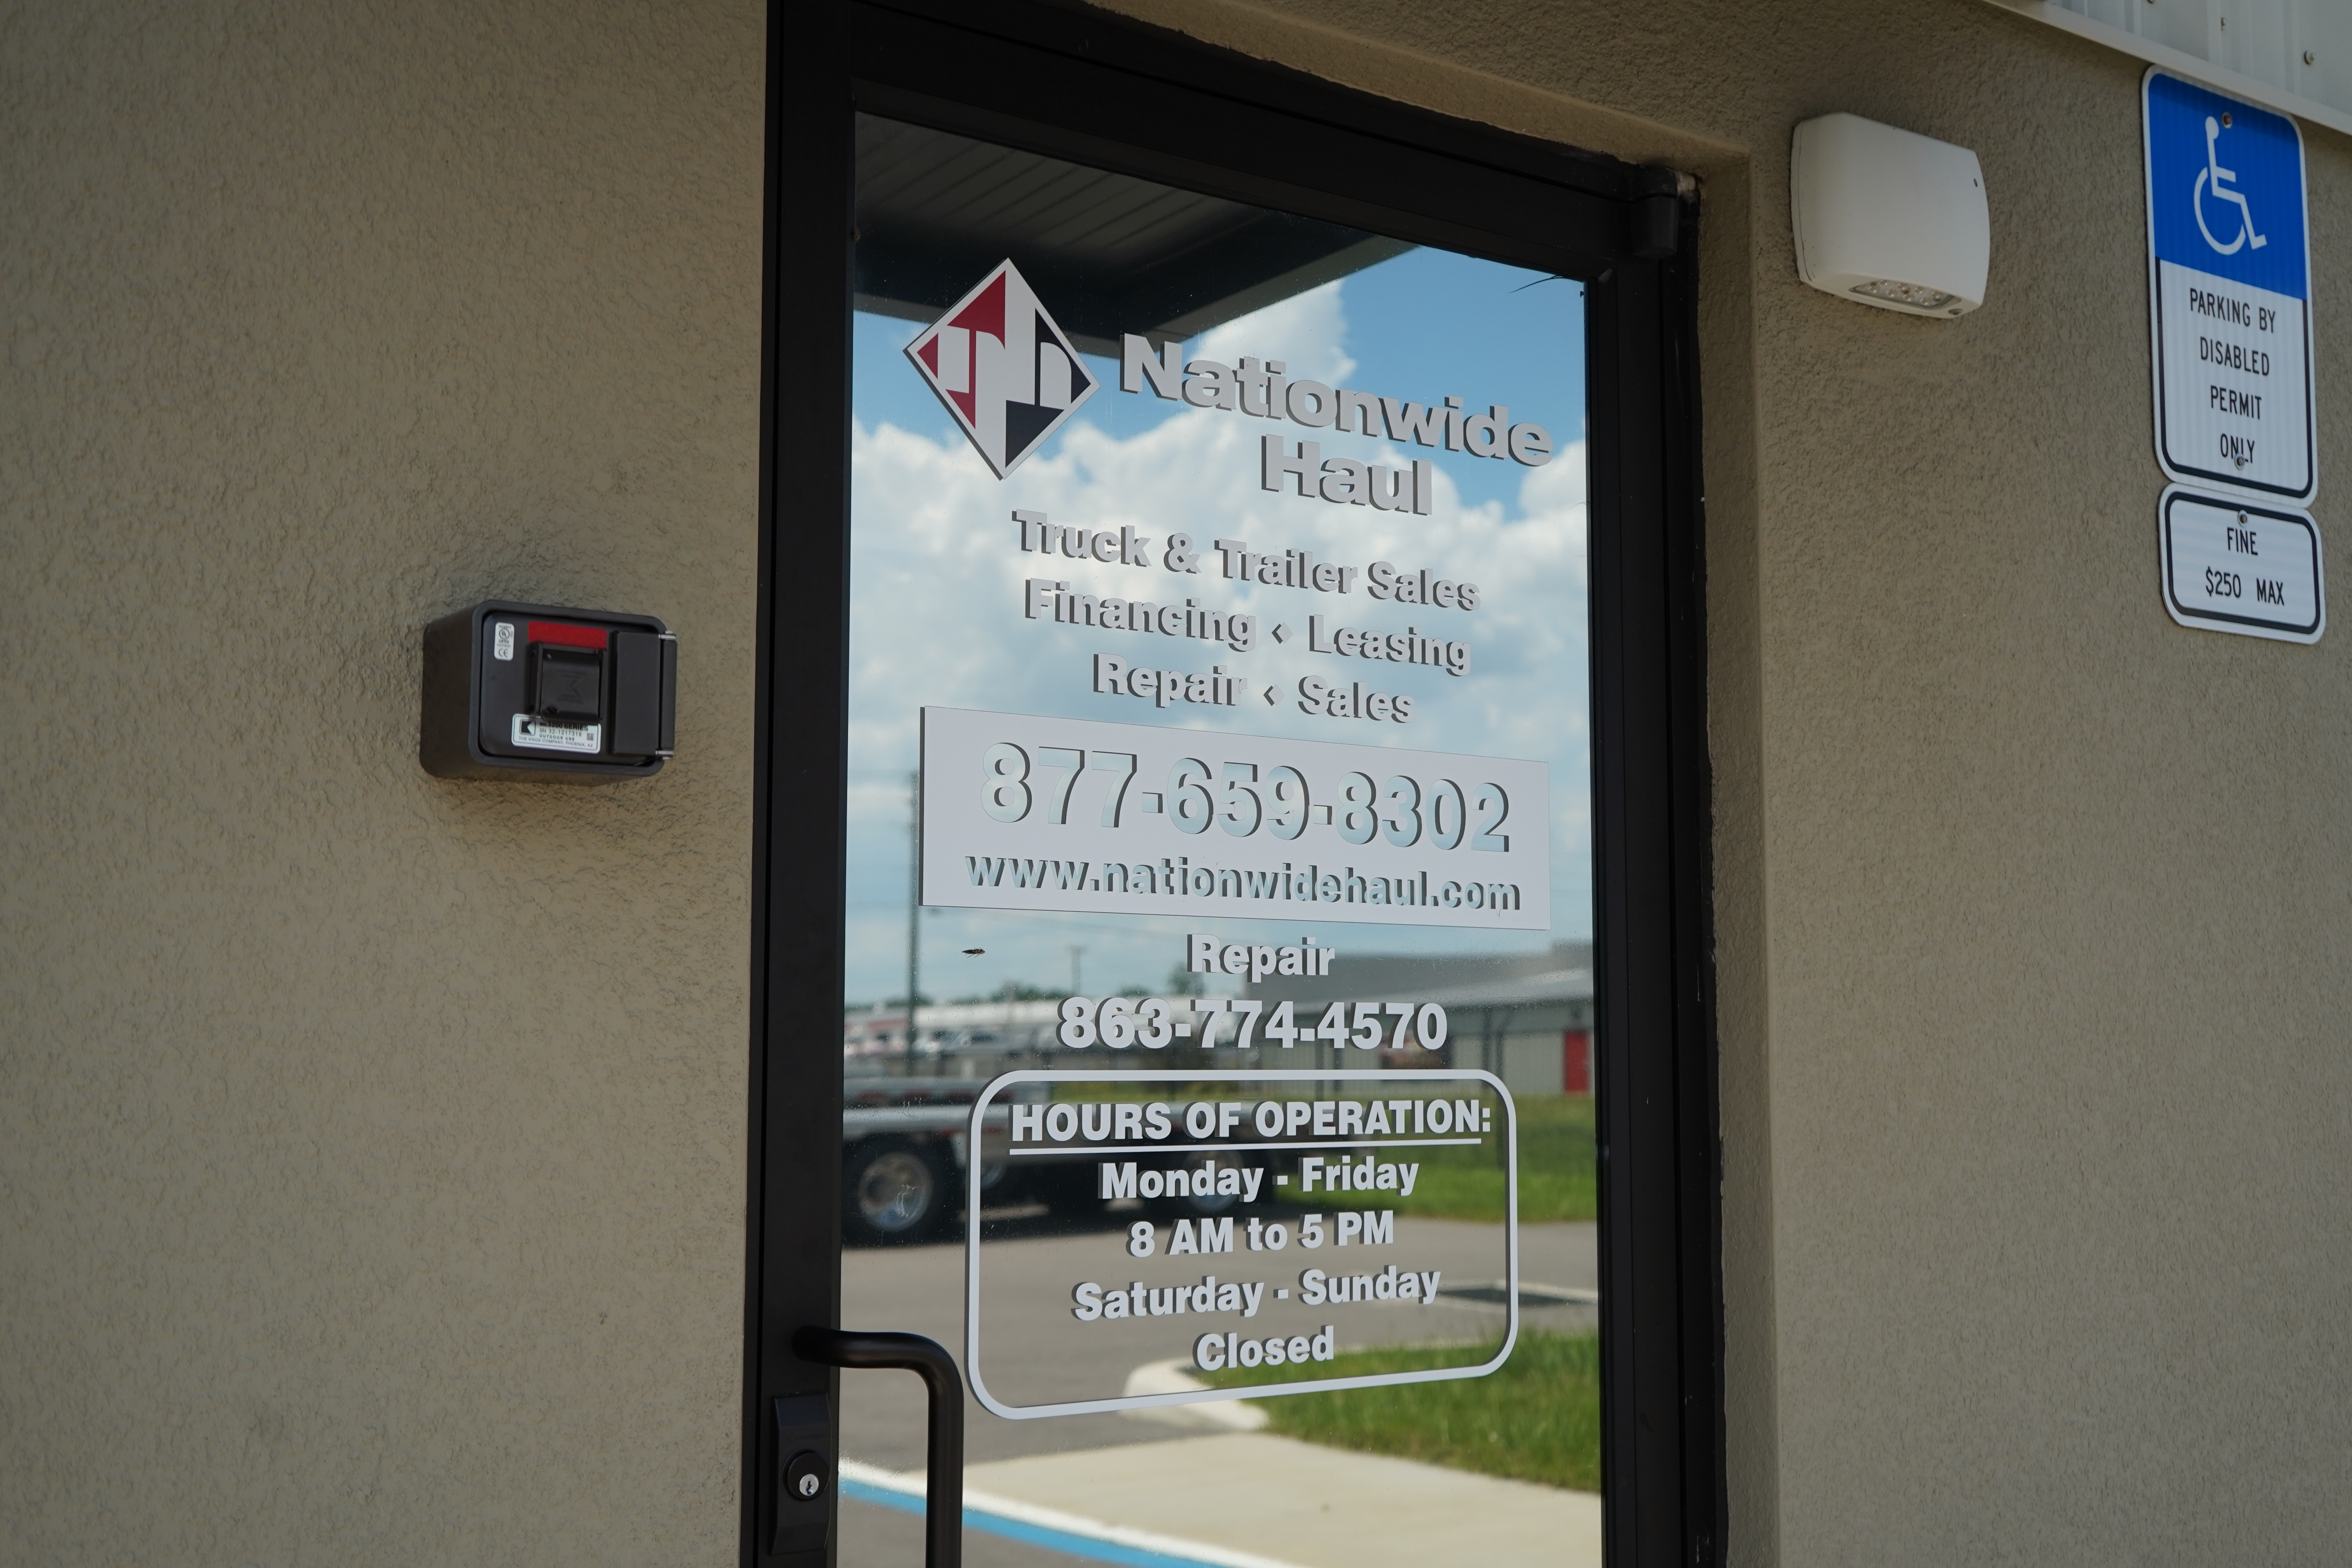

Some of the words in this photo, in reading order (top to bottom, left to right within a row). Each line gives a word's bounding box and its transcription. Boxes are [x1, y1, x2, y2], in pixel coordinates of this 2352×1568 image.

[2190, 287, 2250, 327] PARKING
[2259, 307, 2276, 333] BY
[2200, 336, 2270, 376] DISABLED
[1120, 332, 1553, 467] Nationwide
[2210, 384, 2262, 420] PERMIT
[2220, 433, 2255, 464] ONLY
[1261, 433, 1432, 515] Haul
[1013, 509, 1152, 567] Truck
[1164, 532, 1202, 573] &
[1215, 538, 1358, 593] Trailer
[1367, 561, 1481, 611] Sales
[2227, 526, 2258, 555] FINE
[2205, 566, 2241, 597] $250
[2256, 577, 2285, 606] MAX
[1025, 578, 1256, 652] Financing
[1309, 614, 1472, 677] Leasing
[1093, 653, 1248, 708] Repair
[1298, 675, 1416, 724] Sales
[981, 742, 1510, 853] 877-659-8302
[965, 857, 1521, 911] www.nationwidehaul.com
[1187, 934, 1335, 983] Repair
[1058, 996, 1447, 1050] 863-774-4570
[1009, 1102, 1172, 1142] HOURS
[1183, 1102, 1241, 1139] OF
[1255, 1100, 1490, 1138] OPERATION:
[1098, 1160, 1264, 1202] Monday
[1298, 1155, 1419, 1196] Friday
[1126, 1221, 1155, 1257] 8
[1165, 1217, 1234, 1256] AM
[1243, 1218, 1288, 1251] to
[1298, 1214, 1324, 1249] 5
[1334, 1210, 1394, 1246] PM
[1071, 1276, 1264, 1321] Saturday
[1299, 1265, 1441, 1304] Sunday
[1193, 1325, 1334, 1370] Closed
